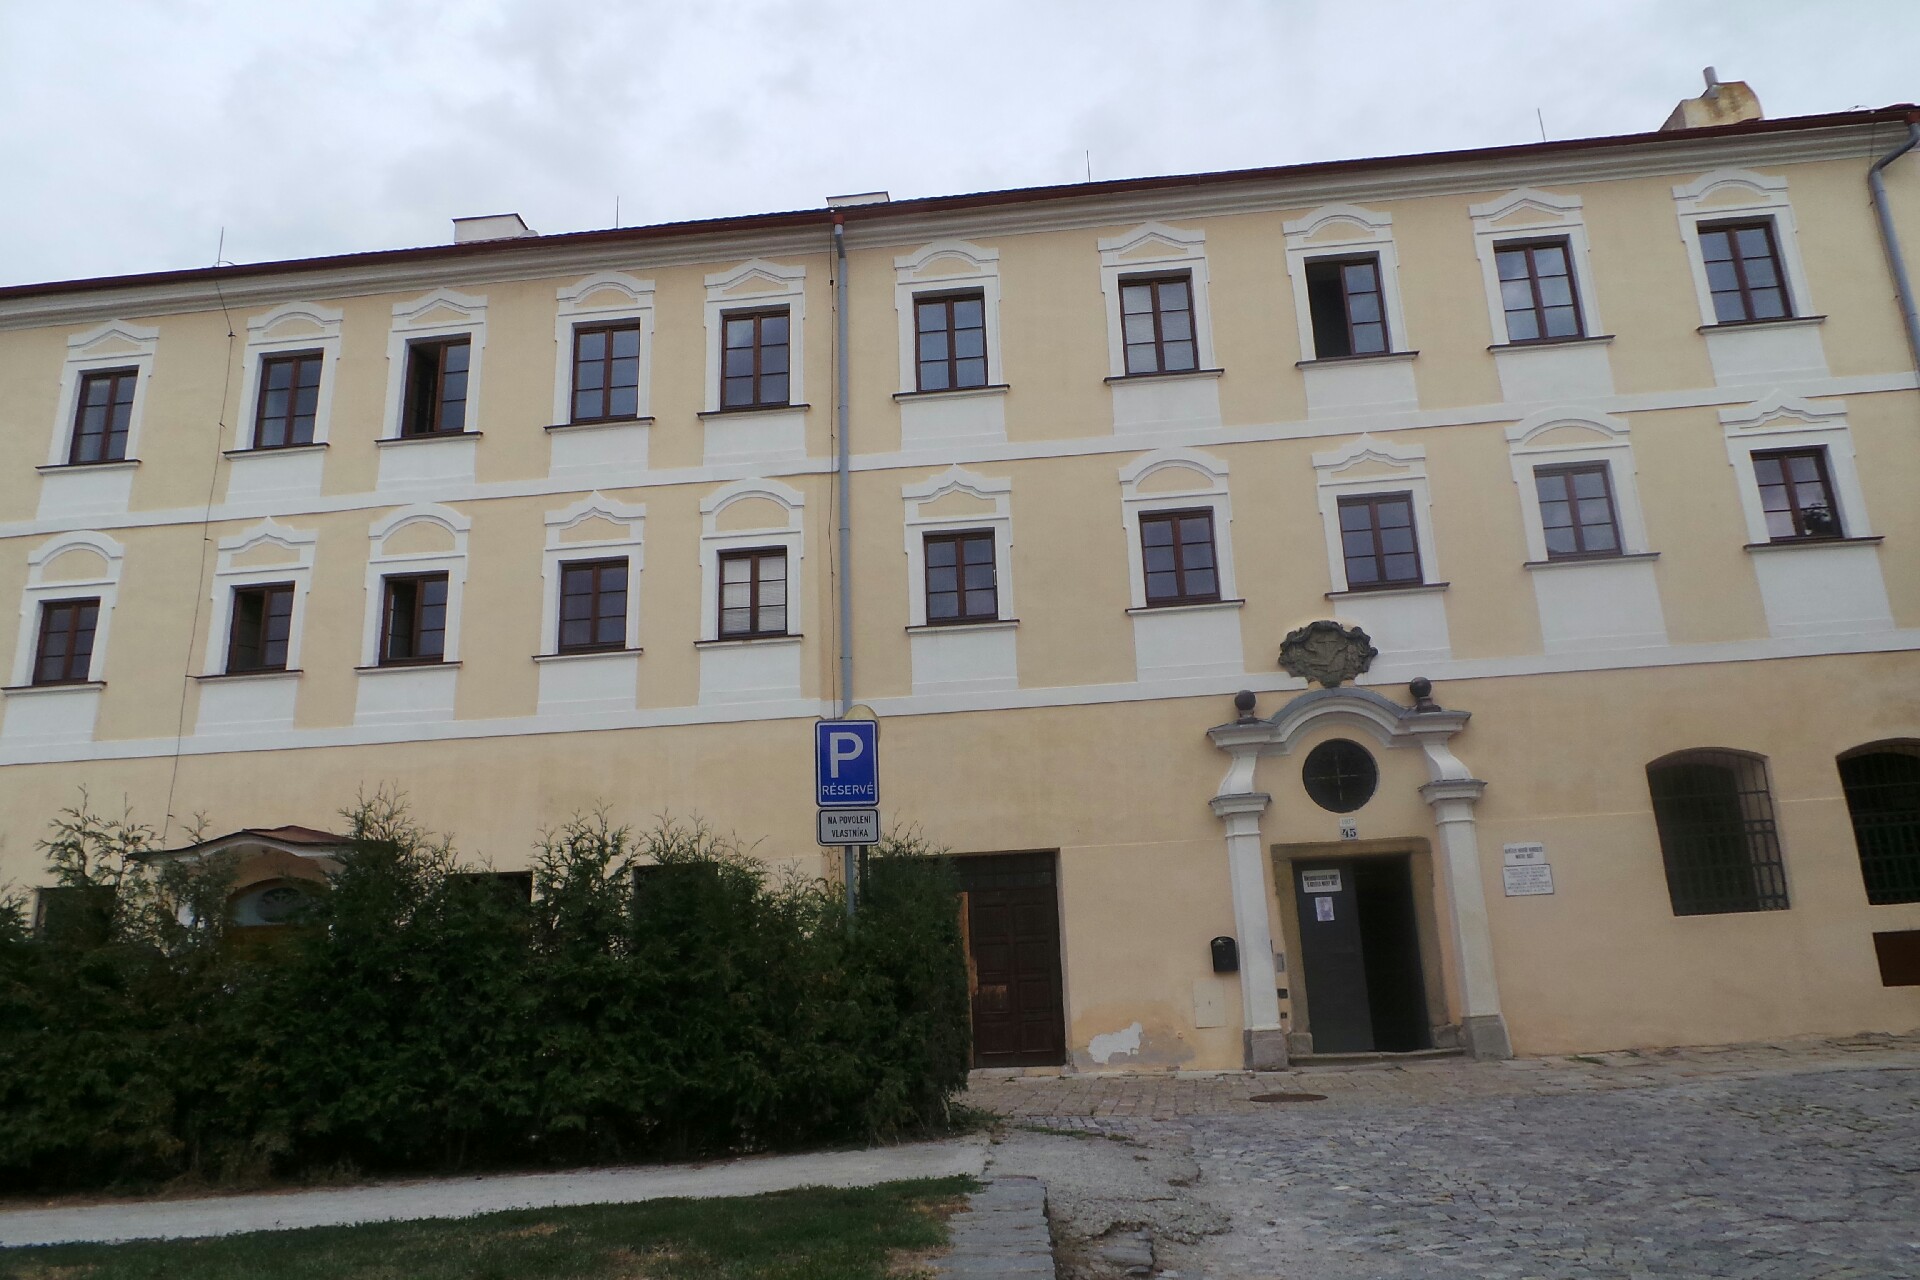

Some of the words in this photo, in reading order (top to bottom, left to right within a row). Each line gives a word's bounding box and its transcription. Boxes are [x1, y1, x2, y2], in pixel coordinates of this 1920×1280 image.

[829, 732, 864, 779] P
[822, 782, 874, 796] RÉSERVÉ
[827, 816, 837, 825] NA
[839, 815, 871, 824] POVOLENÍ
[831, 827, 868, 838] VLASTNÍKA
[1341, 828, 1357, 838] 45
